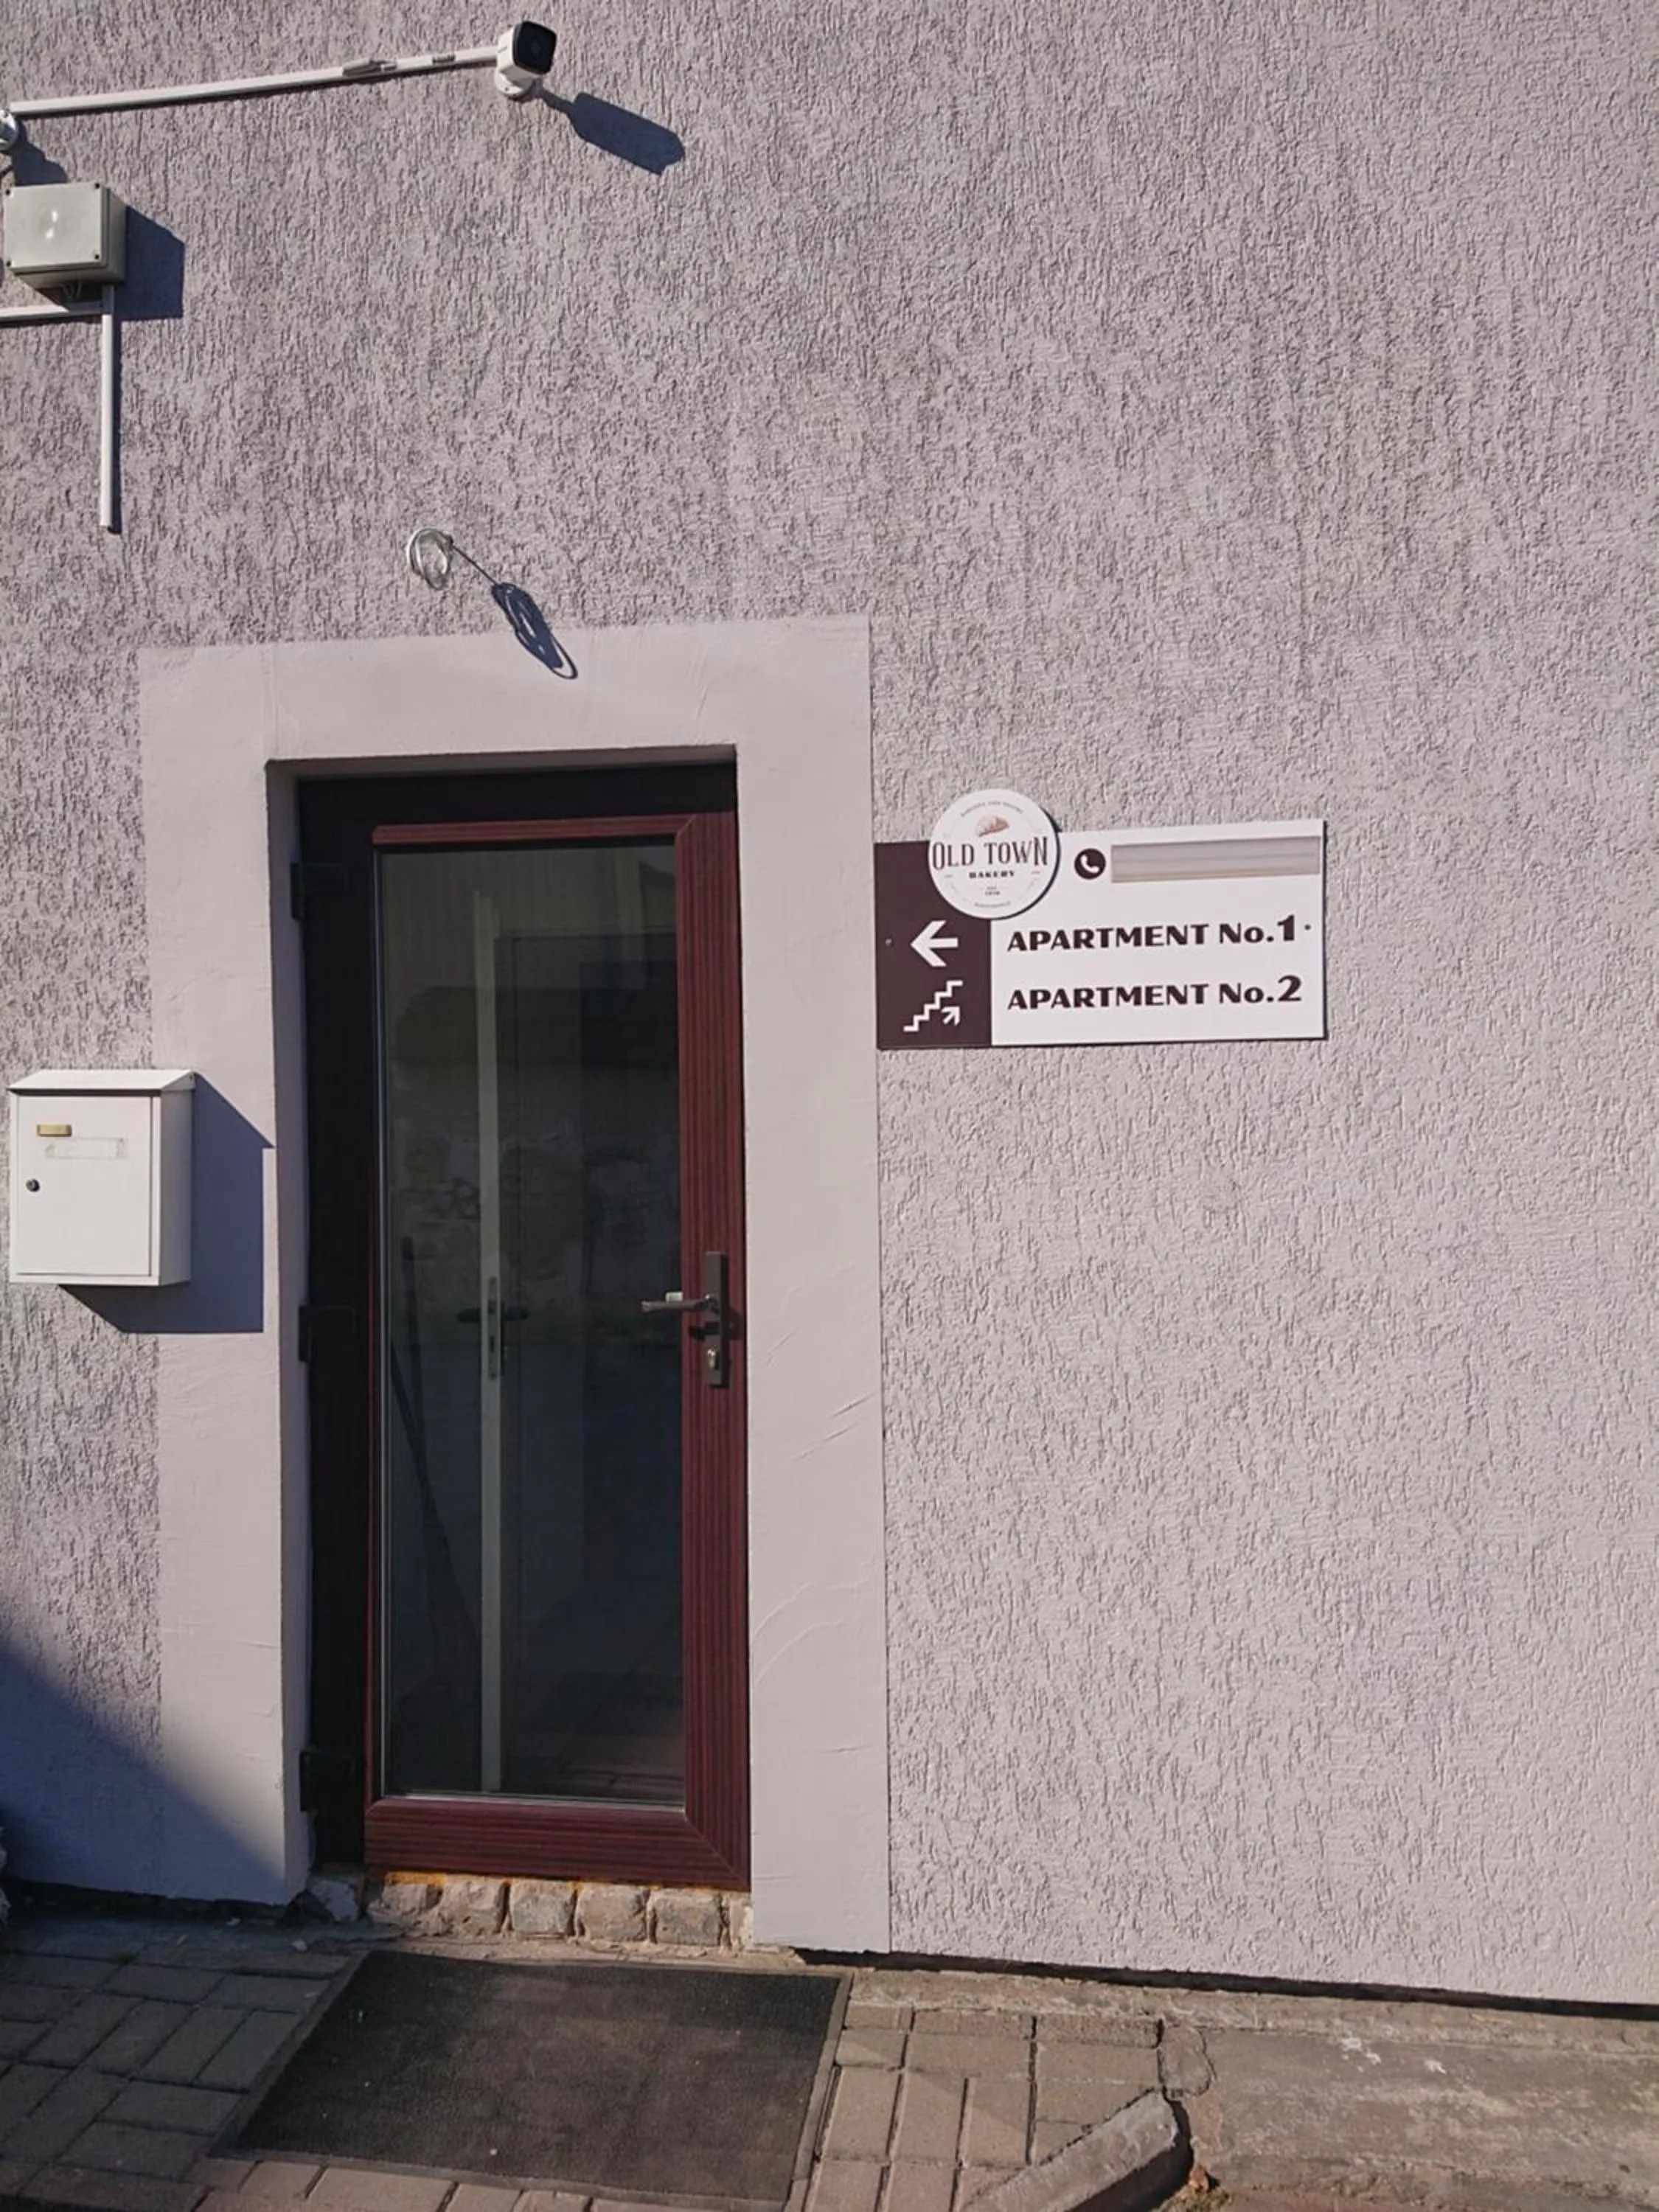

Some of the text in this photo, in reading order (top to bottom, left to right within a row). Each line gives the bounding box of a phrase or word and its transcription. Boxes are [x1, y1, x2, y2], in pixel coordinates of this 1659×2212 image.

[932, 835, 1048, 871] OLD TOWN
[968, 869, 1015, 879] BAKERY
[1006, 914, 1296, 952] APARTMENT No.1
[1006, 975, 1302, 1010] APARTMENT No.2
